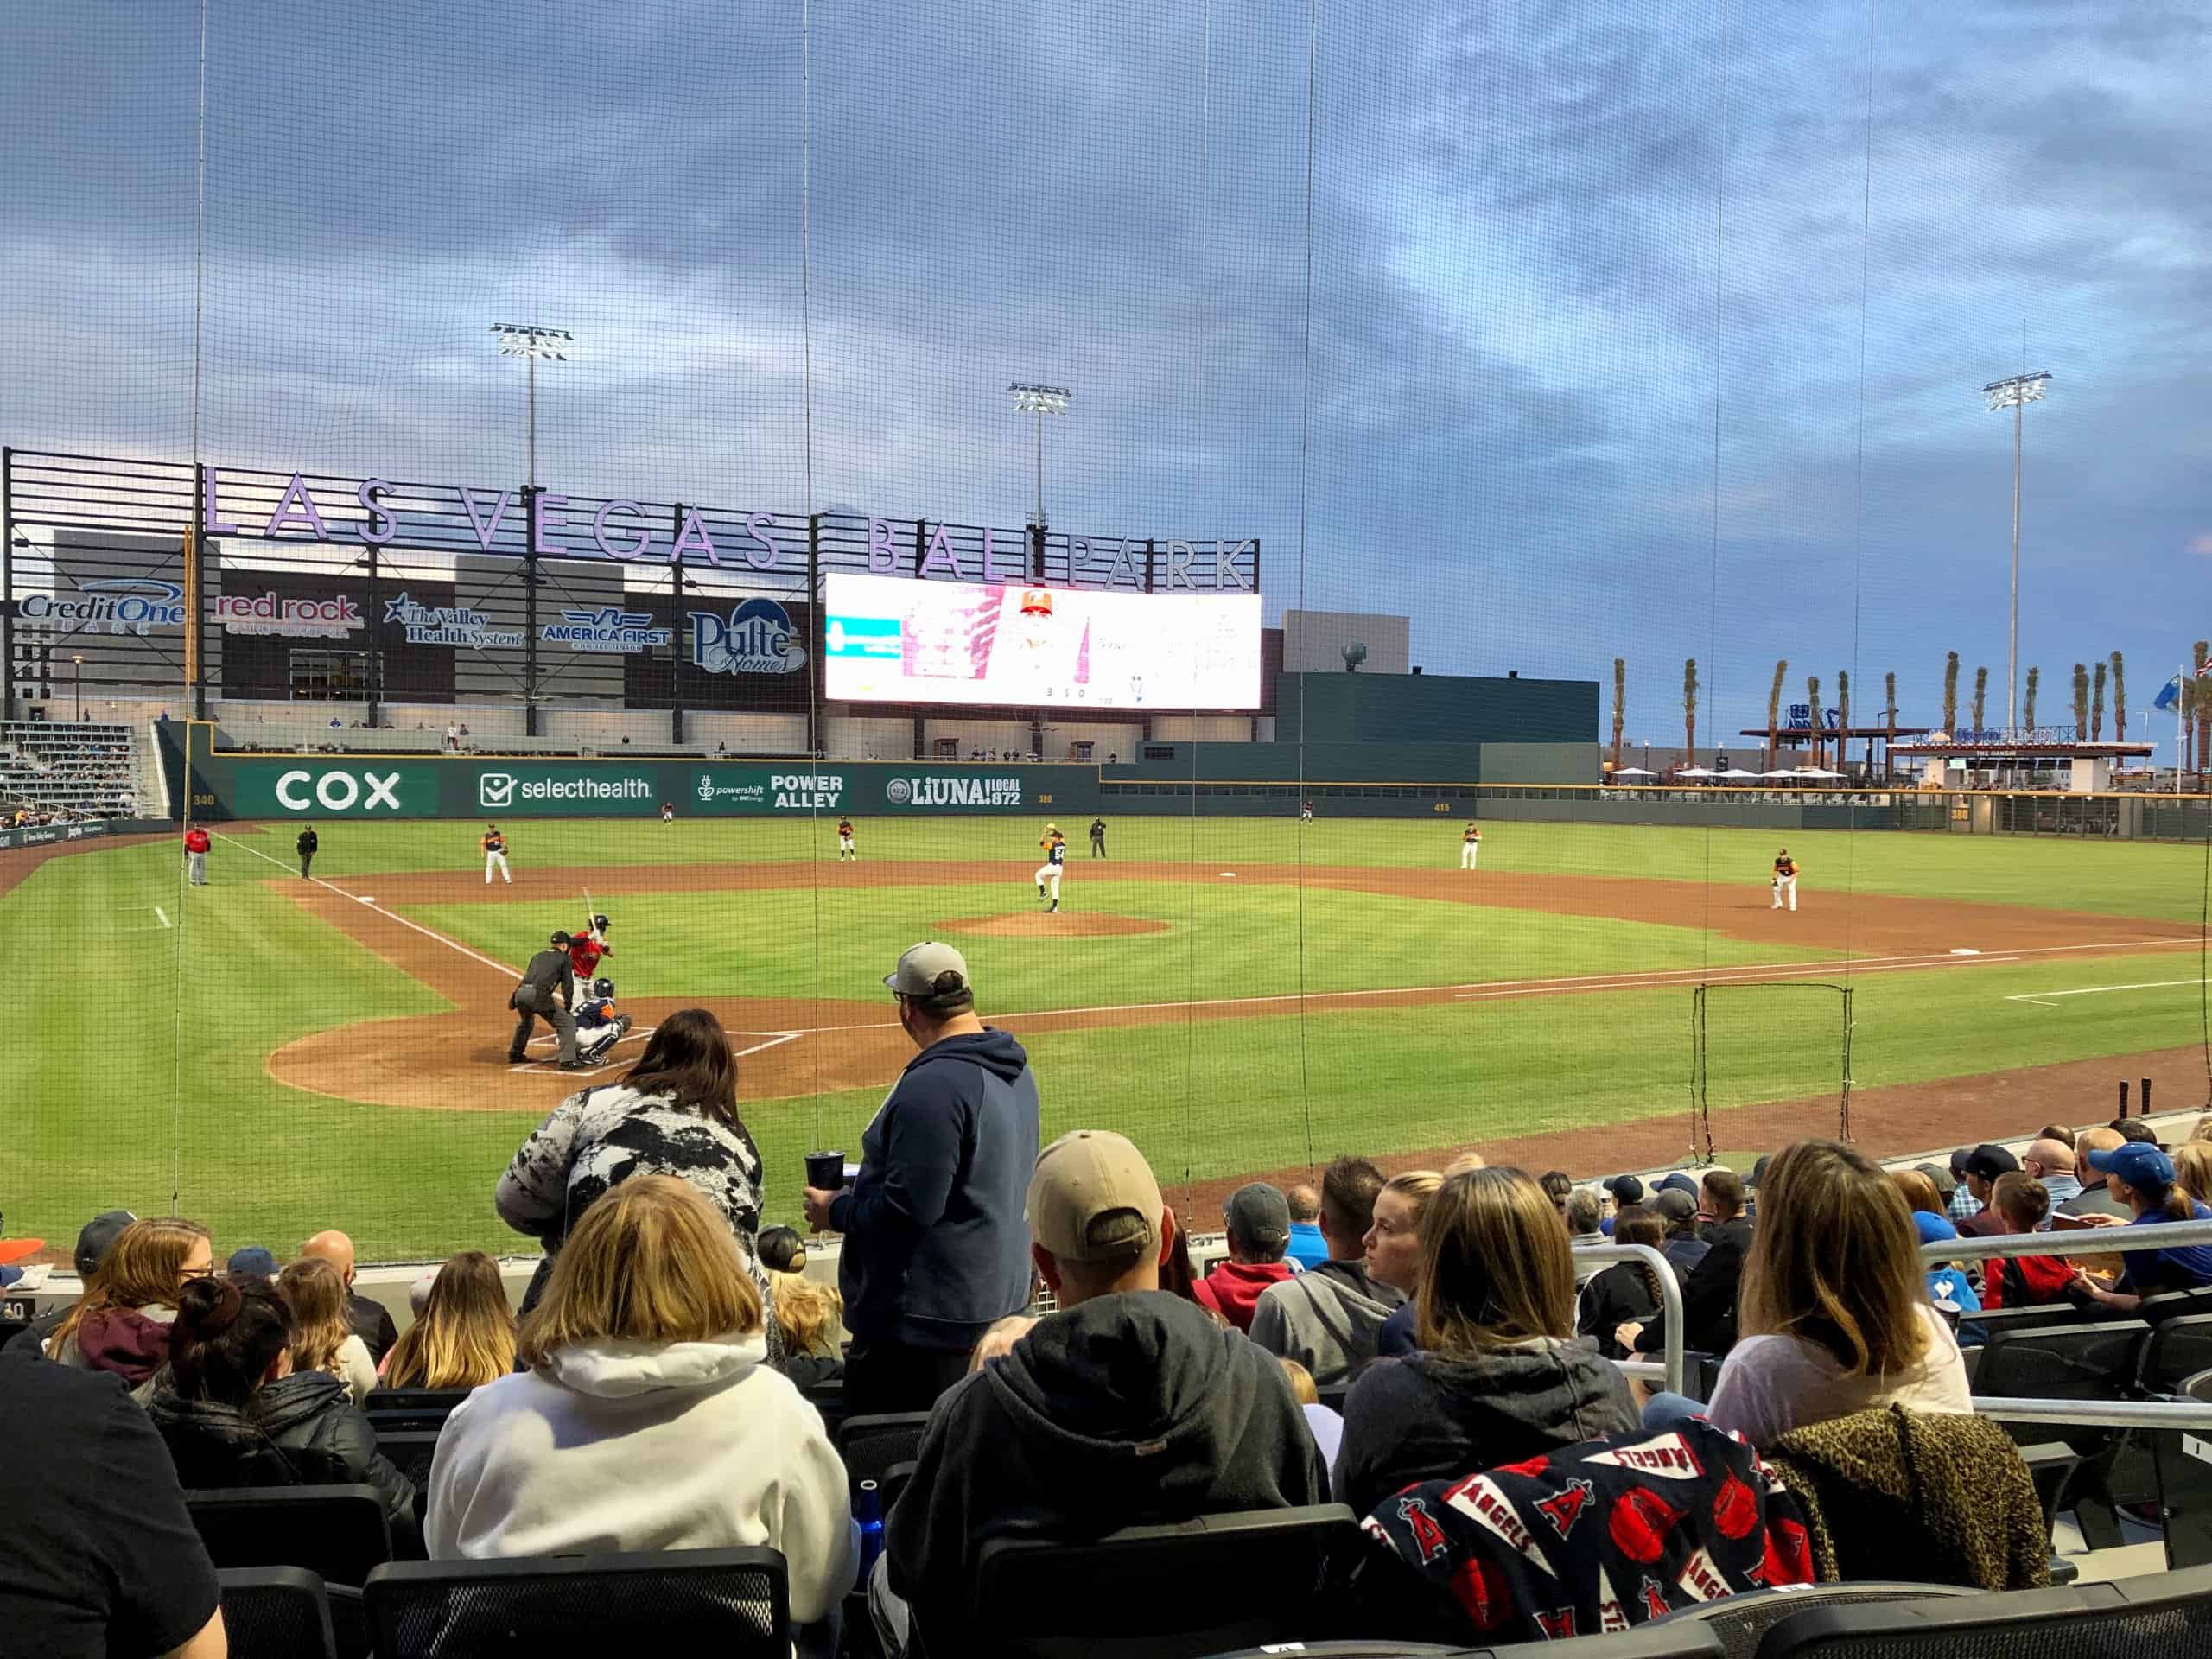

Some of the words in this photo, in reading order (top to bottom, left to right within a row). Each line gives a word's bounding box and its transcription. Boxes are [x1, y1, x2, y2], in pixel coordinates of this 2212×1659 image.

[205, 469, 398, 544] LAS
[458, 486, 779, 569] VEGAS
[218, 594, 274, 618] red
[284, 597, 356, 621] rock
[408, 608, 439, 624] The
[438, 608, 489, 630] Valley
[409, 627, 468, 644] Health
[470, 632, 521, 649] System
[544, 626, 616, 642] AMERICA
[622, 631, 671, 645] FIRST
[689, 612, 790, 664] Pulte
[276, 771, 401, 810] COX
[715, 785, 764, 797] powershift
[771, 775, 843, 791] POWER
[991, 779, 1021, 791] LOCAL
[193, 794, 215, 806] 340
[774, 792, 840, 808] ALLEY
[991, 792, 1020, 805] 872
[1433, 803, 1451, 812] 415
[1612, 1446, 1690, 1473] ANGELS
[1460, 1481, 1536, 1554] ANGELS
